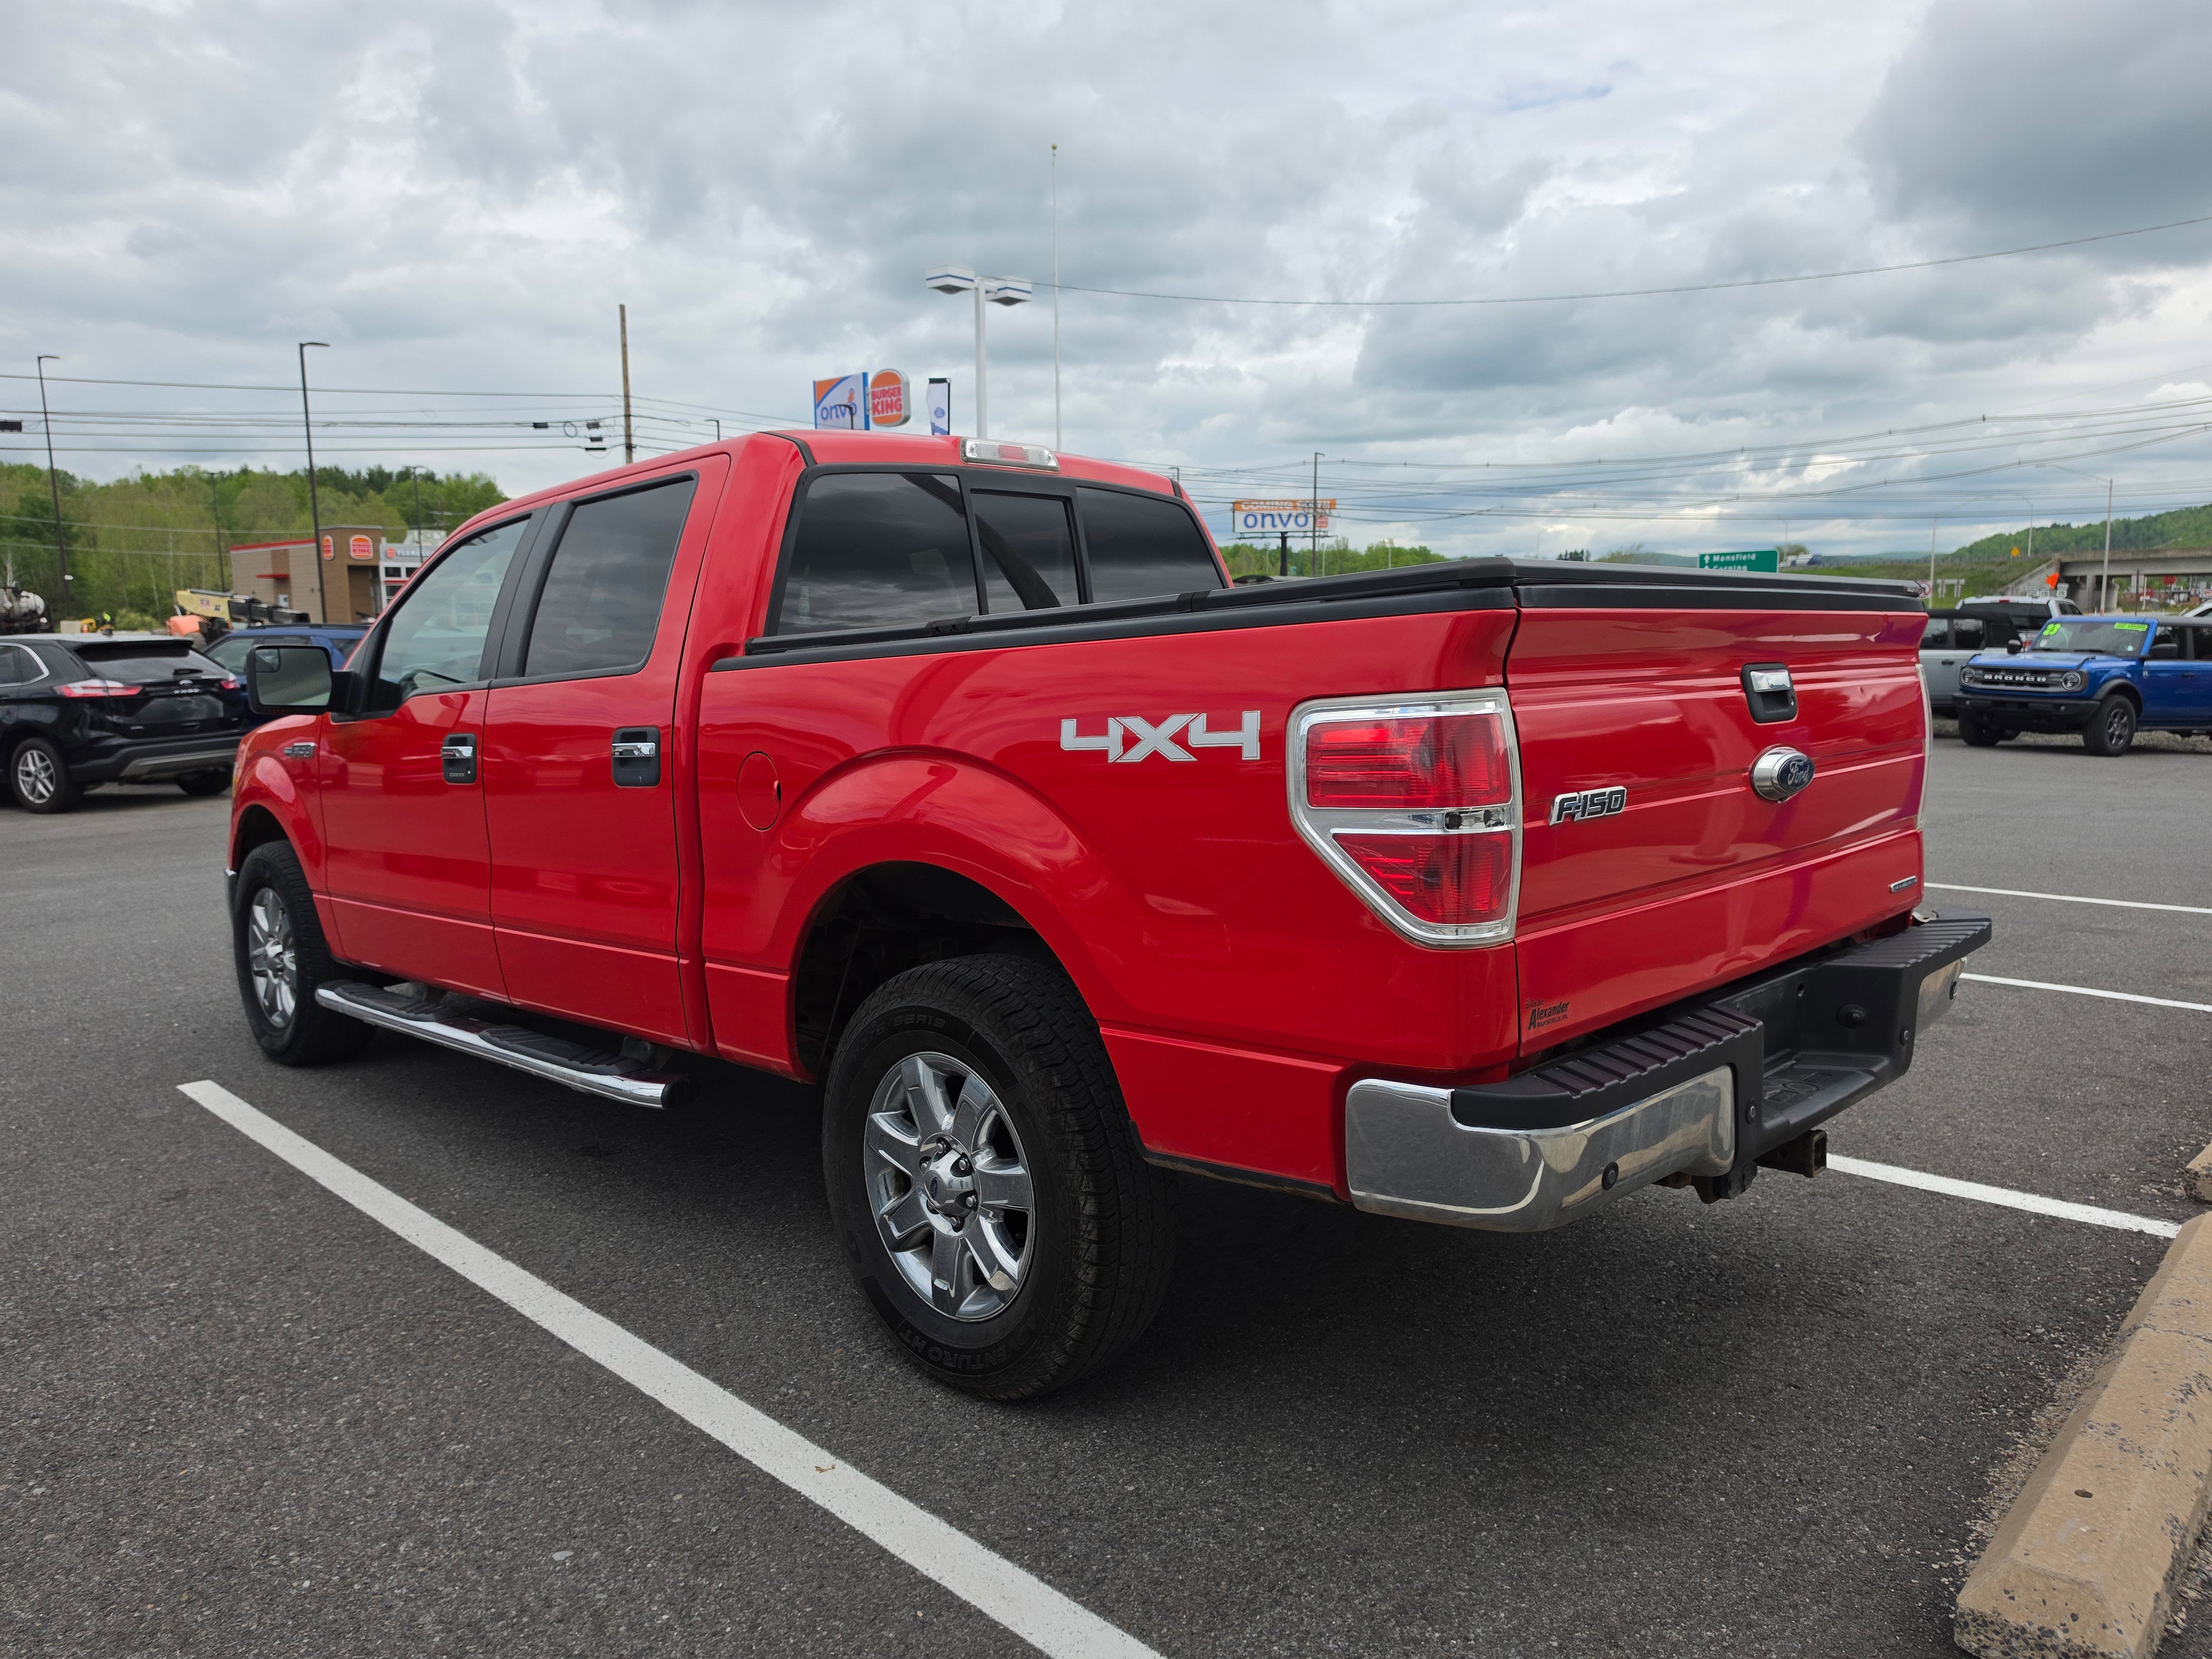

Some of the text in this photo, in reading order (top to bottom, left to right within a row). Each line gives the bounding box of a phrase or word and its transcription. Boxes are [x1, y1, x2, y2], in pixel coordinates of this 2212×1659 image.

[872, 387, 901, 400] BURGER
[821, 402, 857, 420] onvo
[872, 398, 902, 415] KING
[1241, 500, 1293, 510] COMING
[1244, 513, 1308, 529] onvo
[1713, 552, 1756, 562] Mansfield
[1787, 760, 1810, 785] Ford
[1550, 786, 1627, 826] F-150
[1528, 1001, 1569, 1030] Alexander
